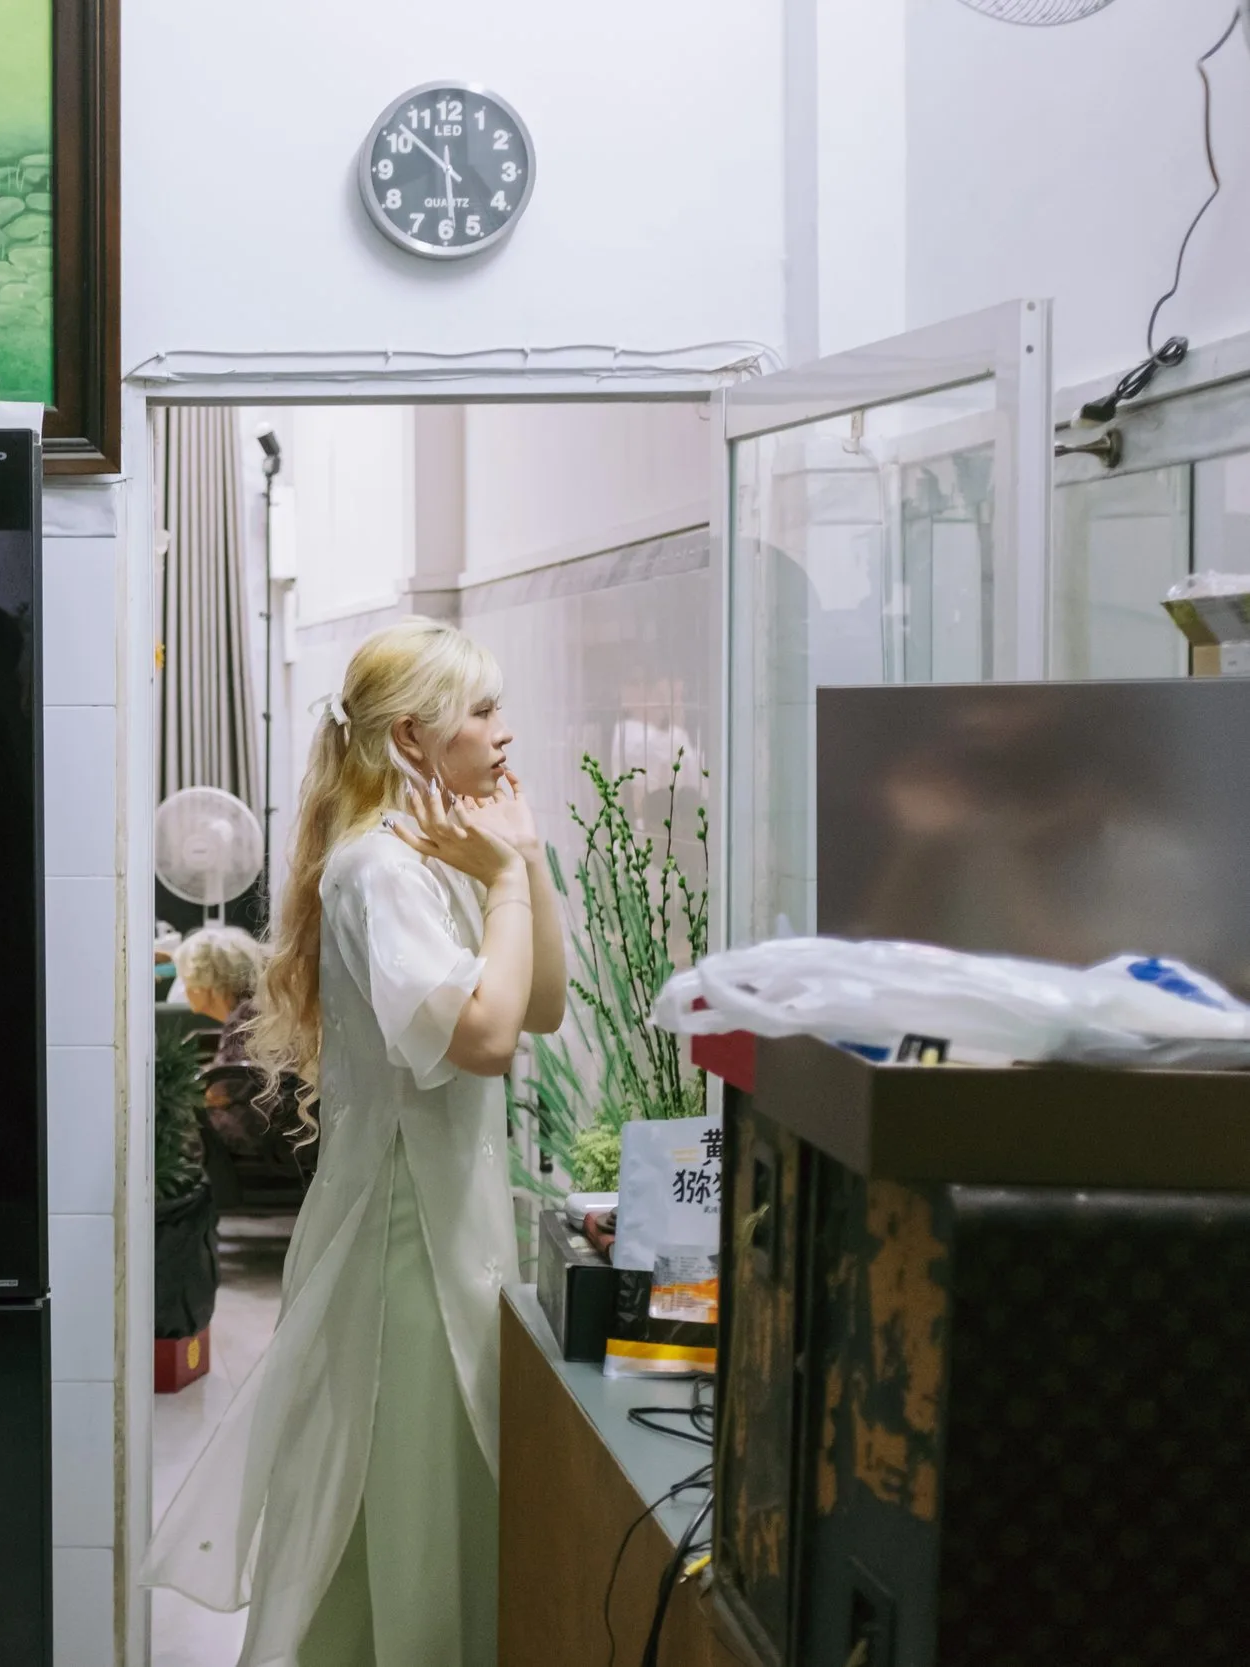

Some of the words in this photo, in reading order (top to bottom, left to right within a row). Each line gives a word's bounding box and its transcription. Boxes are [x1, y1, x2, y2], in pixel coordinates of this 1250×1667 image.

[407, 109, 431, 129] 11
[436, 100, 463, 121] 12
[474, 110, 485, 131] 1
[434, 125, 462, 136] LED
[493, 130, 510, 150] 2
[386, 132, 413, 153] 10
[377, 159, 394, 180] 9
[501, 161, 517, 182] 3
[385, 188, 402, 209] 8
[424, 197, 470, 208] QUATZ
[490, 190, 507, 211] 4
[409, 212, 426, 233] 7
[438, 219, 454, 240] 6
[465, 215, 481, 236] 5
